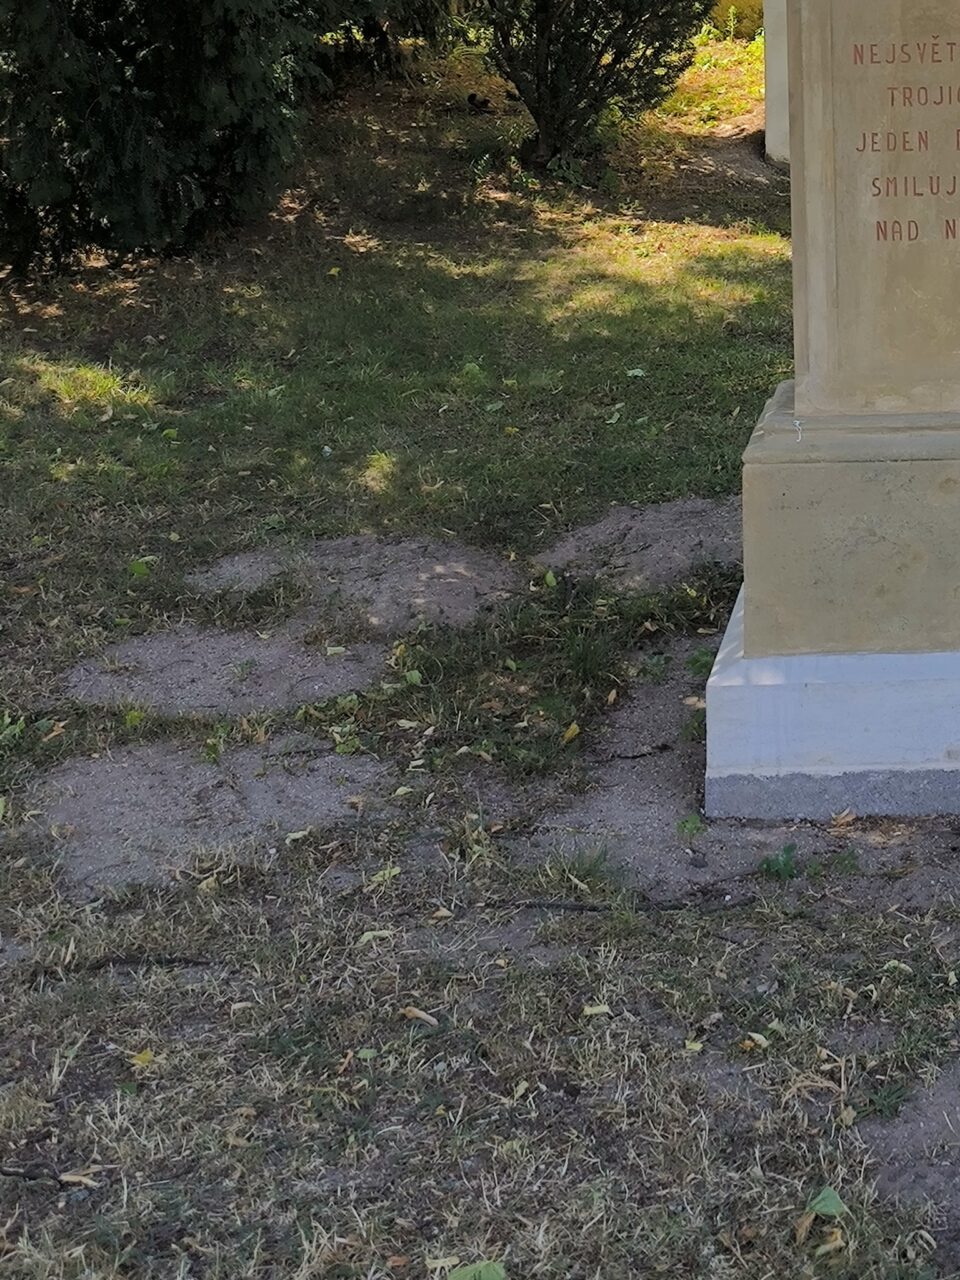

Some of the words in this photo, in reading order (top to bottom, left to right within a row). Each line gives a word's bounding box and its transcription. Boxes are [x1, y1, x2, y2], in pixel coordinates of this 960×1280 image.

[856, 130, 929, 152] JEDEN
[871, 175, 957, 197] SMILUJ
[876, 220, 919, 241] NAD
